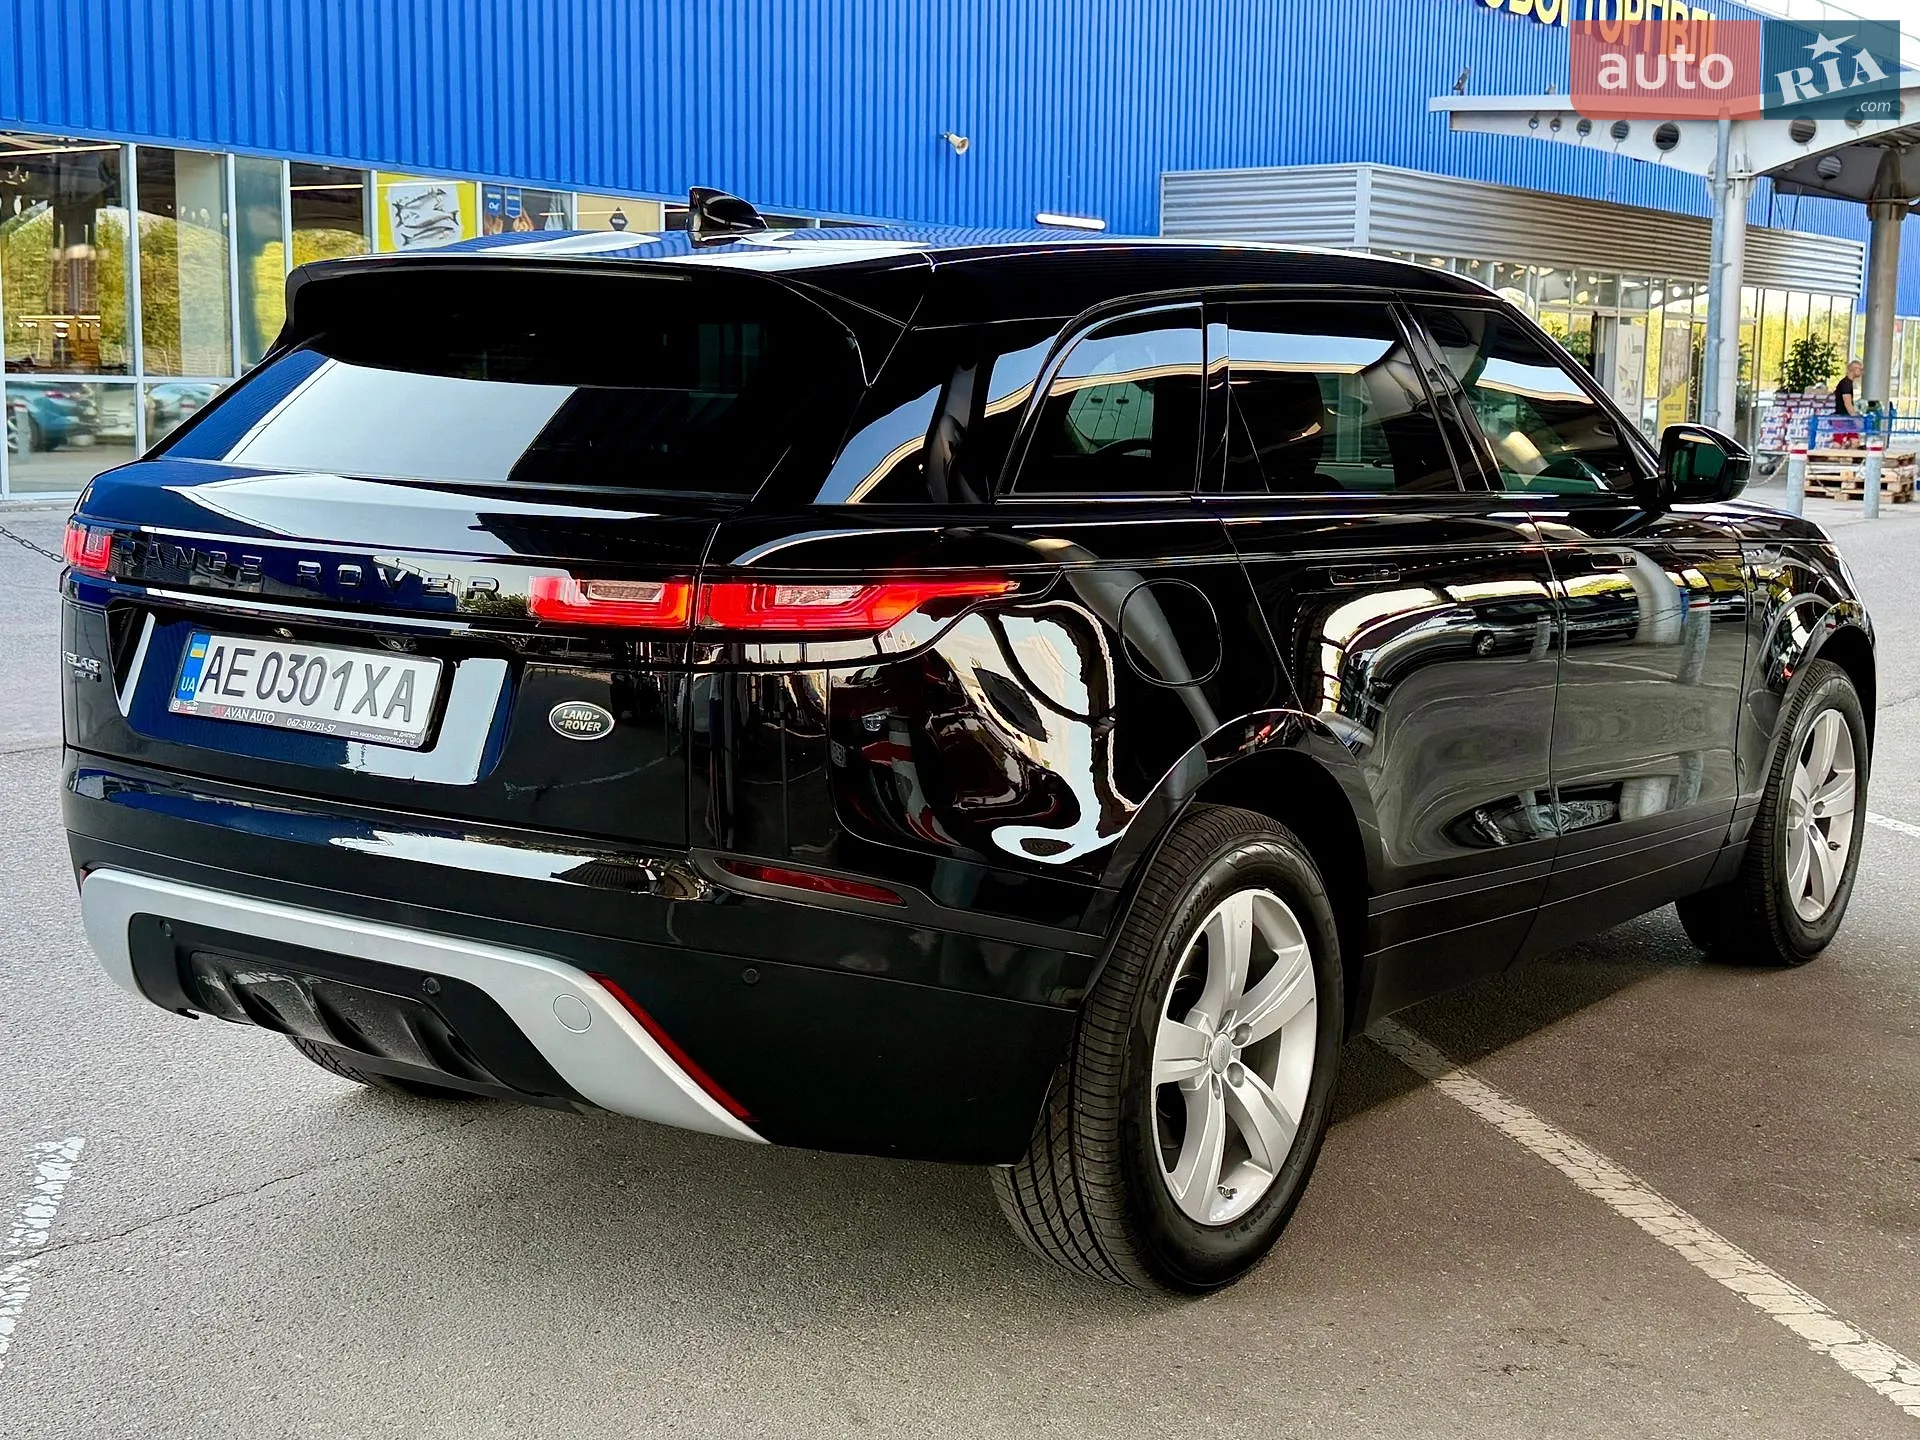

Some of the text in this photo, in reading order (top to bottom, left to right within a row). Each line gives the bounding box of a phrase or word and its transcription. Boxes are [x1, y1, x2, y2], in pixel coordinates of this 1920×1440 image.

[119, 538, 501, 601] RANGE ROVER
[181, 677, 195, 692] UA
[199, 645, 416, 723] AE 0301 XA
[249, 710, 275, 724] AUTO
[563, 709, 593, 721] LAND
[564, 720, 602, 732] ROVER
